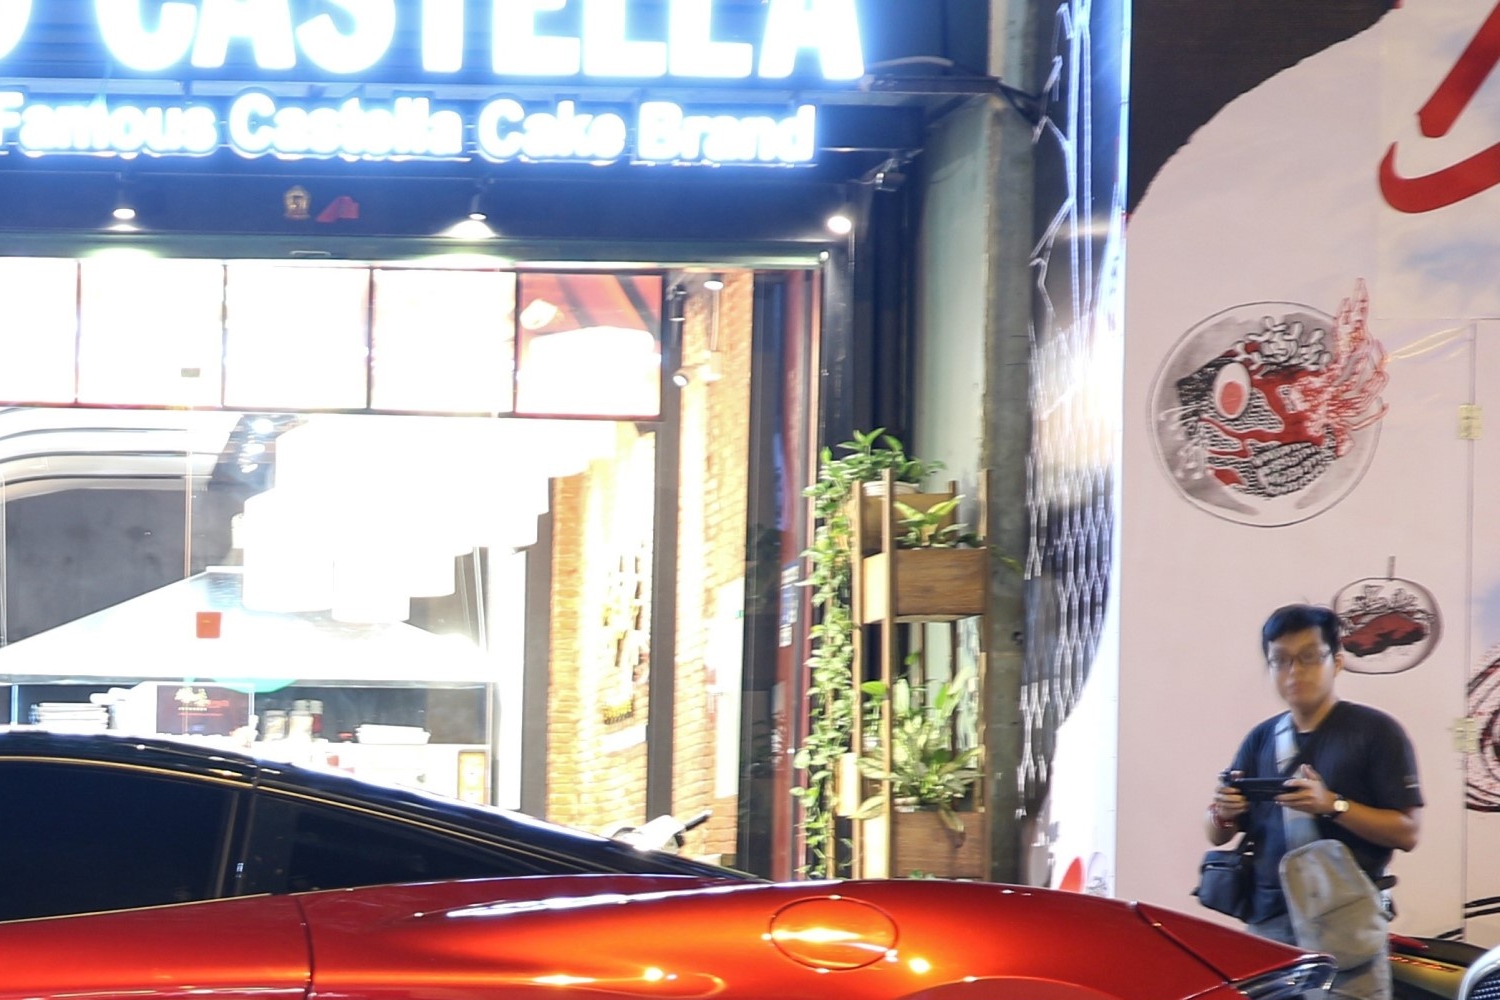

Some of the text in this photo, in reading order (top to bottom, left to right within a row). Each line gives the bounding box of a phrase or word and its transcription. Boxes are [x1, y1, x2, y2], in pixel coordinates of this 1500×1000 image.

[228, 92, 464, 156] Castella
[478, 98, 627, 159] Cake
[637, 101, 817, 163] Brand
